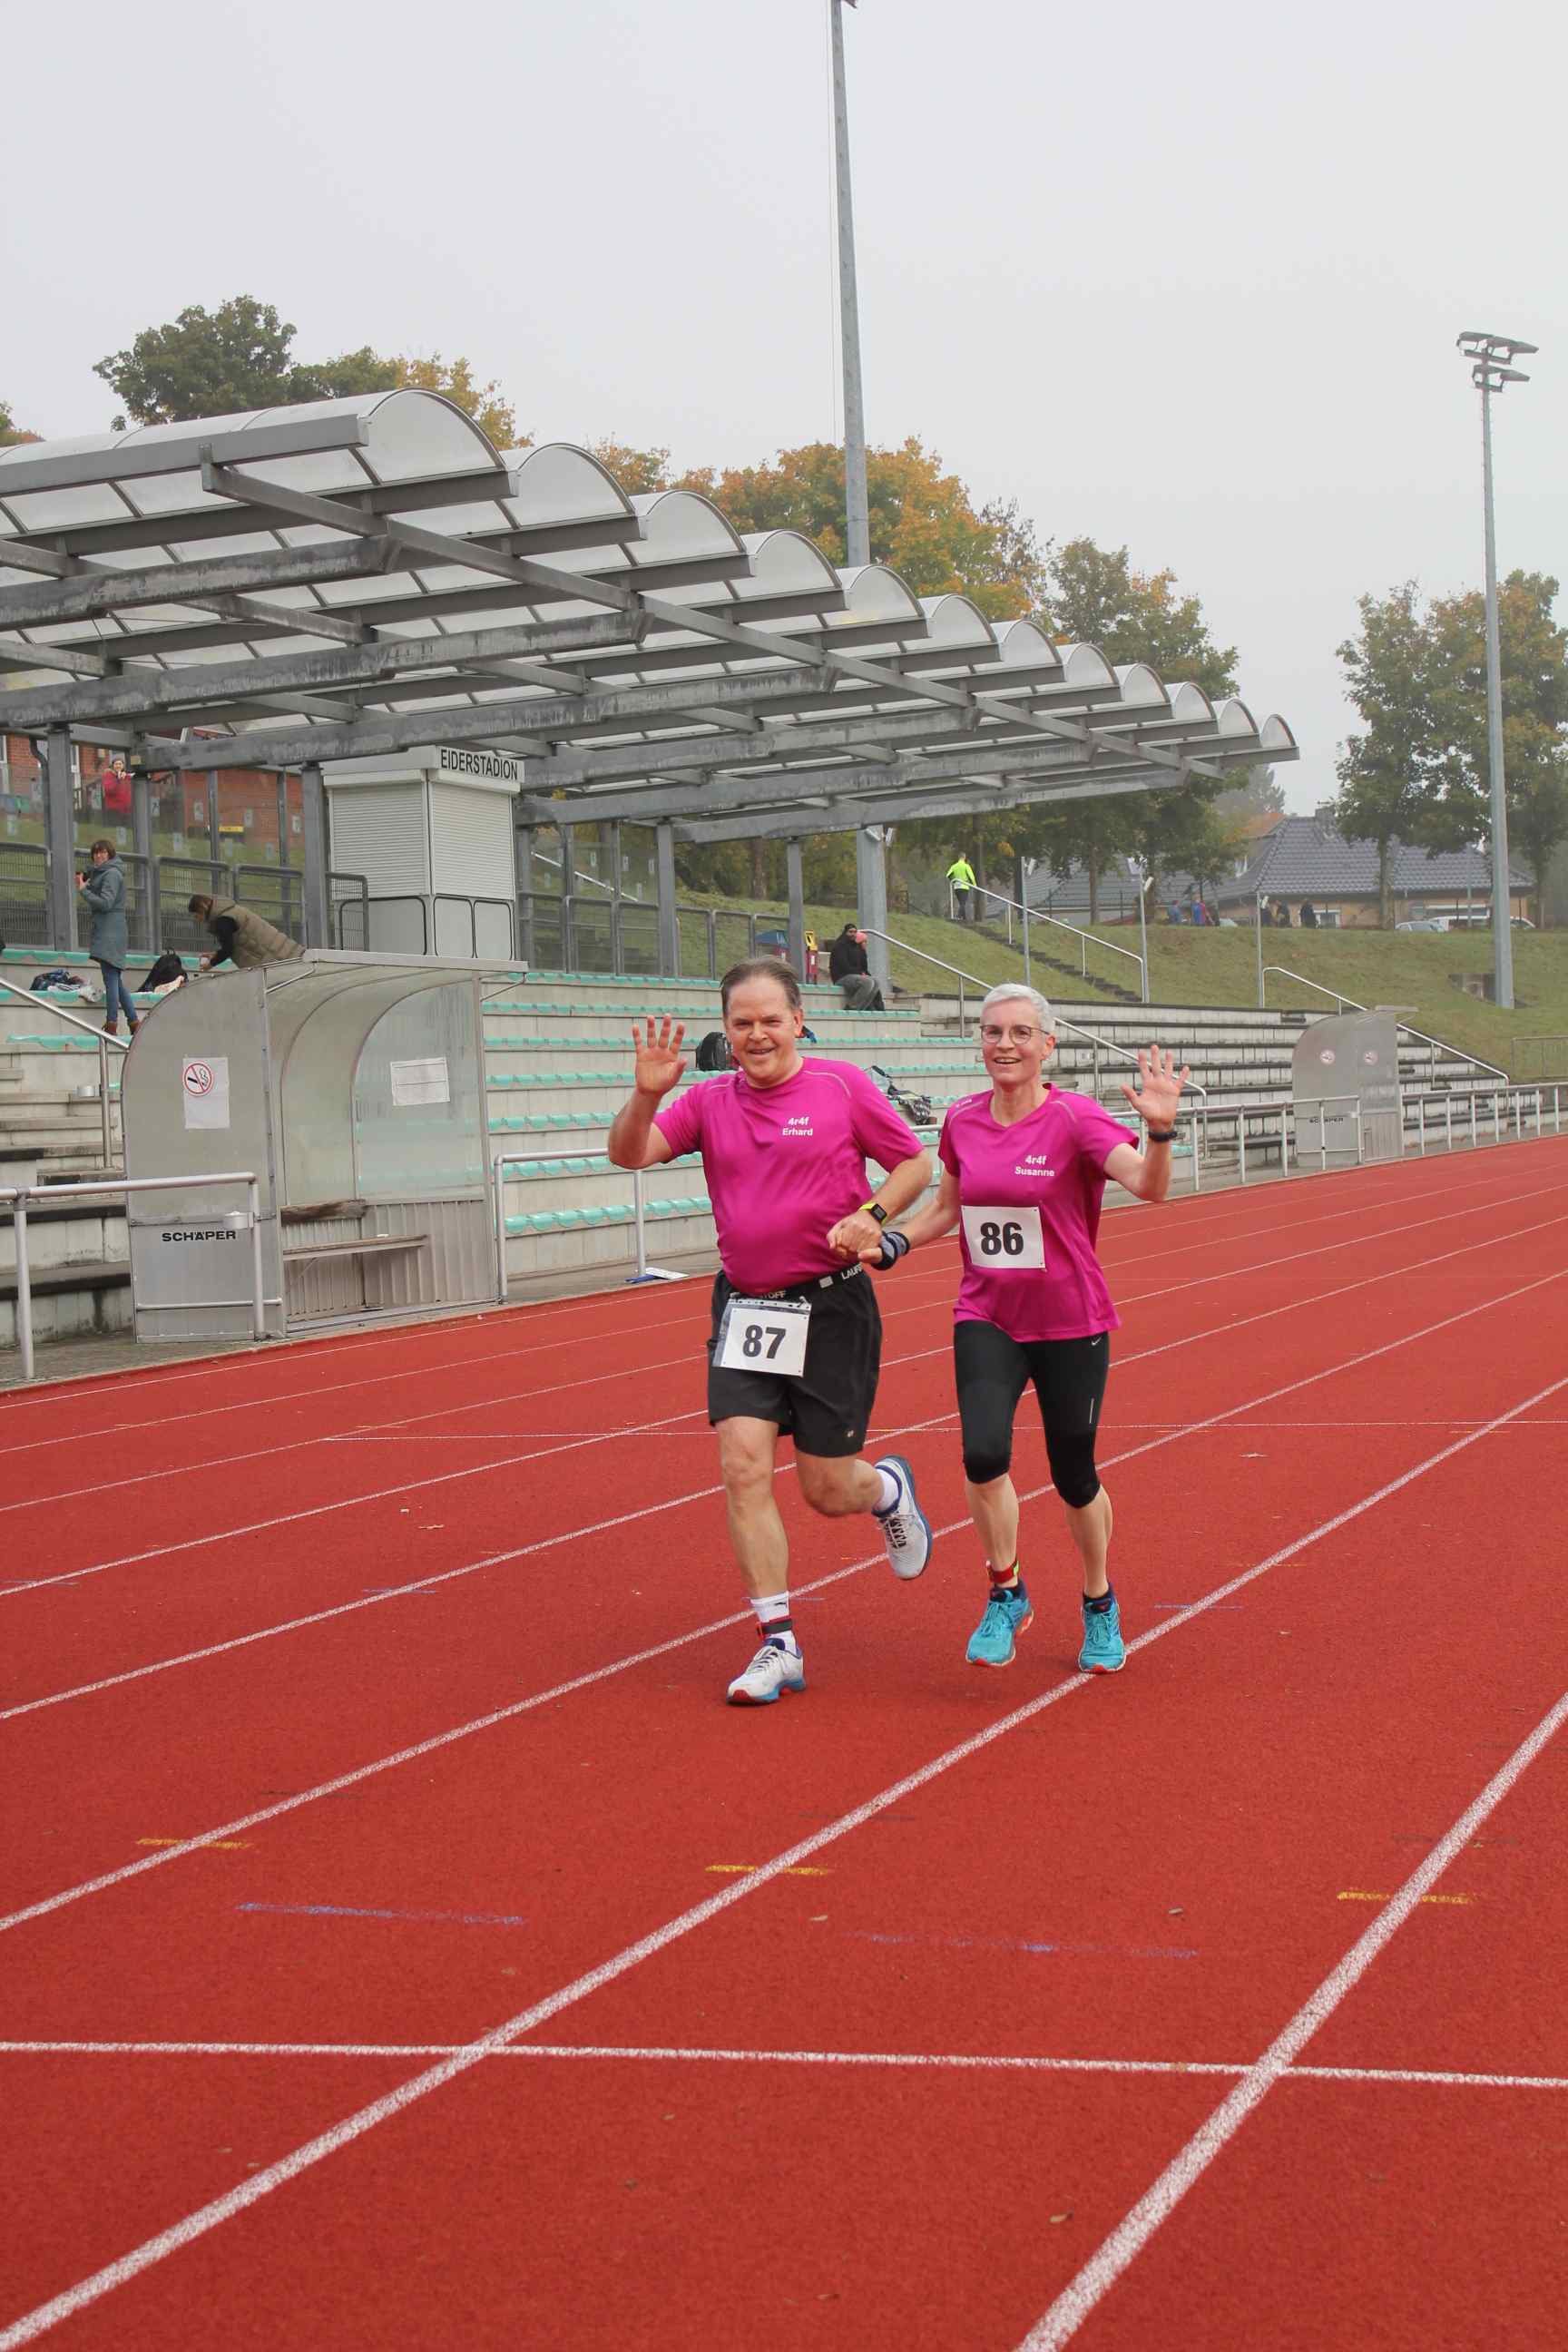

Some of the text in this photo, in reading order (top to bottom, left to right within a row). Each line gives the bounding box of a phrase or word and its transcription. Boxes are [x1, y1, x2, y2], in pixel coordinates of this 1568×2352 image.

[440, 749, 518, 780] EIDERSTADION
[788, 1116, 810, 1126] 4r4f
[782, 1127, 814, 1136] Erhard
[1025, 1154, 1047, 1165] 4r4f
[1014, 1165, 1055, 1177] Susanne
[162, 1230, 237, 1242] SCHÄPER
[980, 1221, 1024, 1256] 86
[742, 1324, 787, 1359] 87
